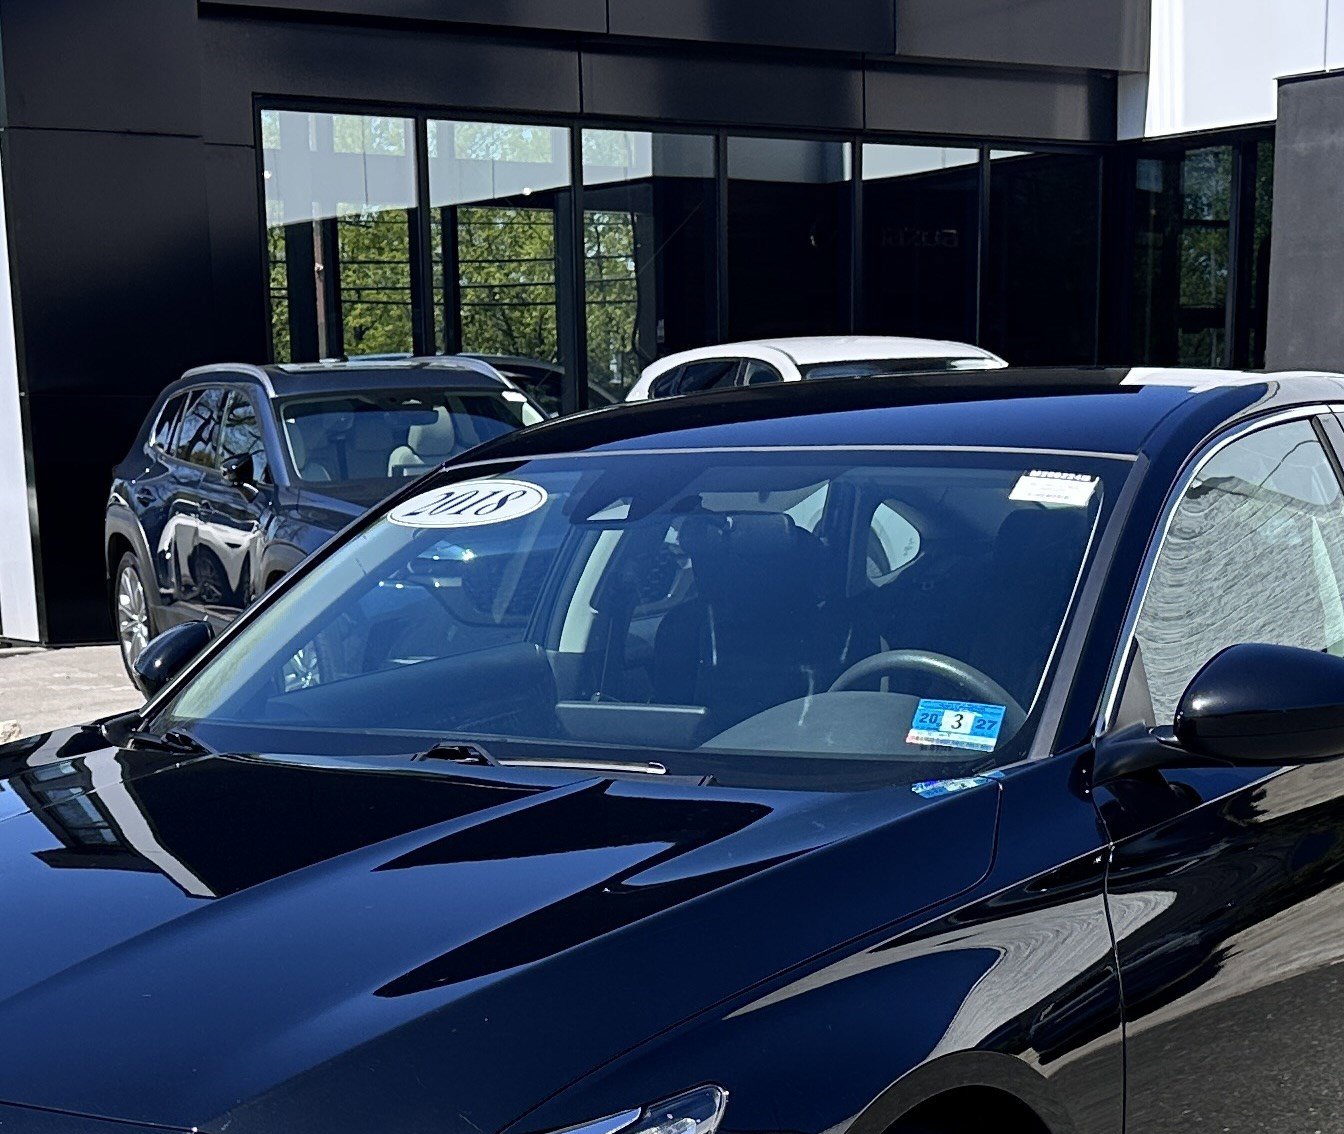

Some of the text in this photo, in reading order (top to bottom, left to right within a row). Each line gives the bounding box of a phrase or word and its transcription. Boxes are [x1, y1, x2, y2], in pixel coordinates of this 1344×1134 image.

[402, 489, 528, 518] 2018
[951, 713, 964, 730] 3
[976, 719, 997, 730] 27
